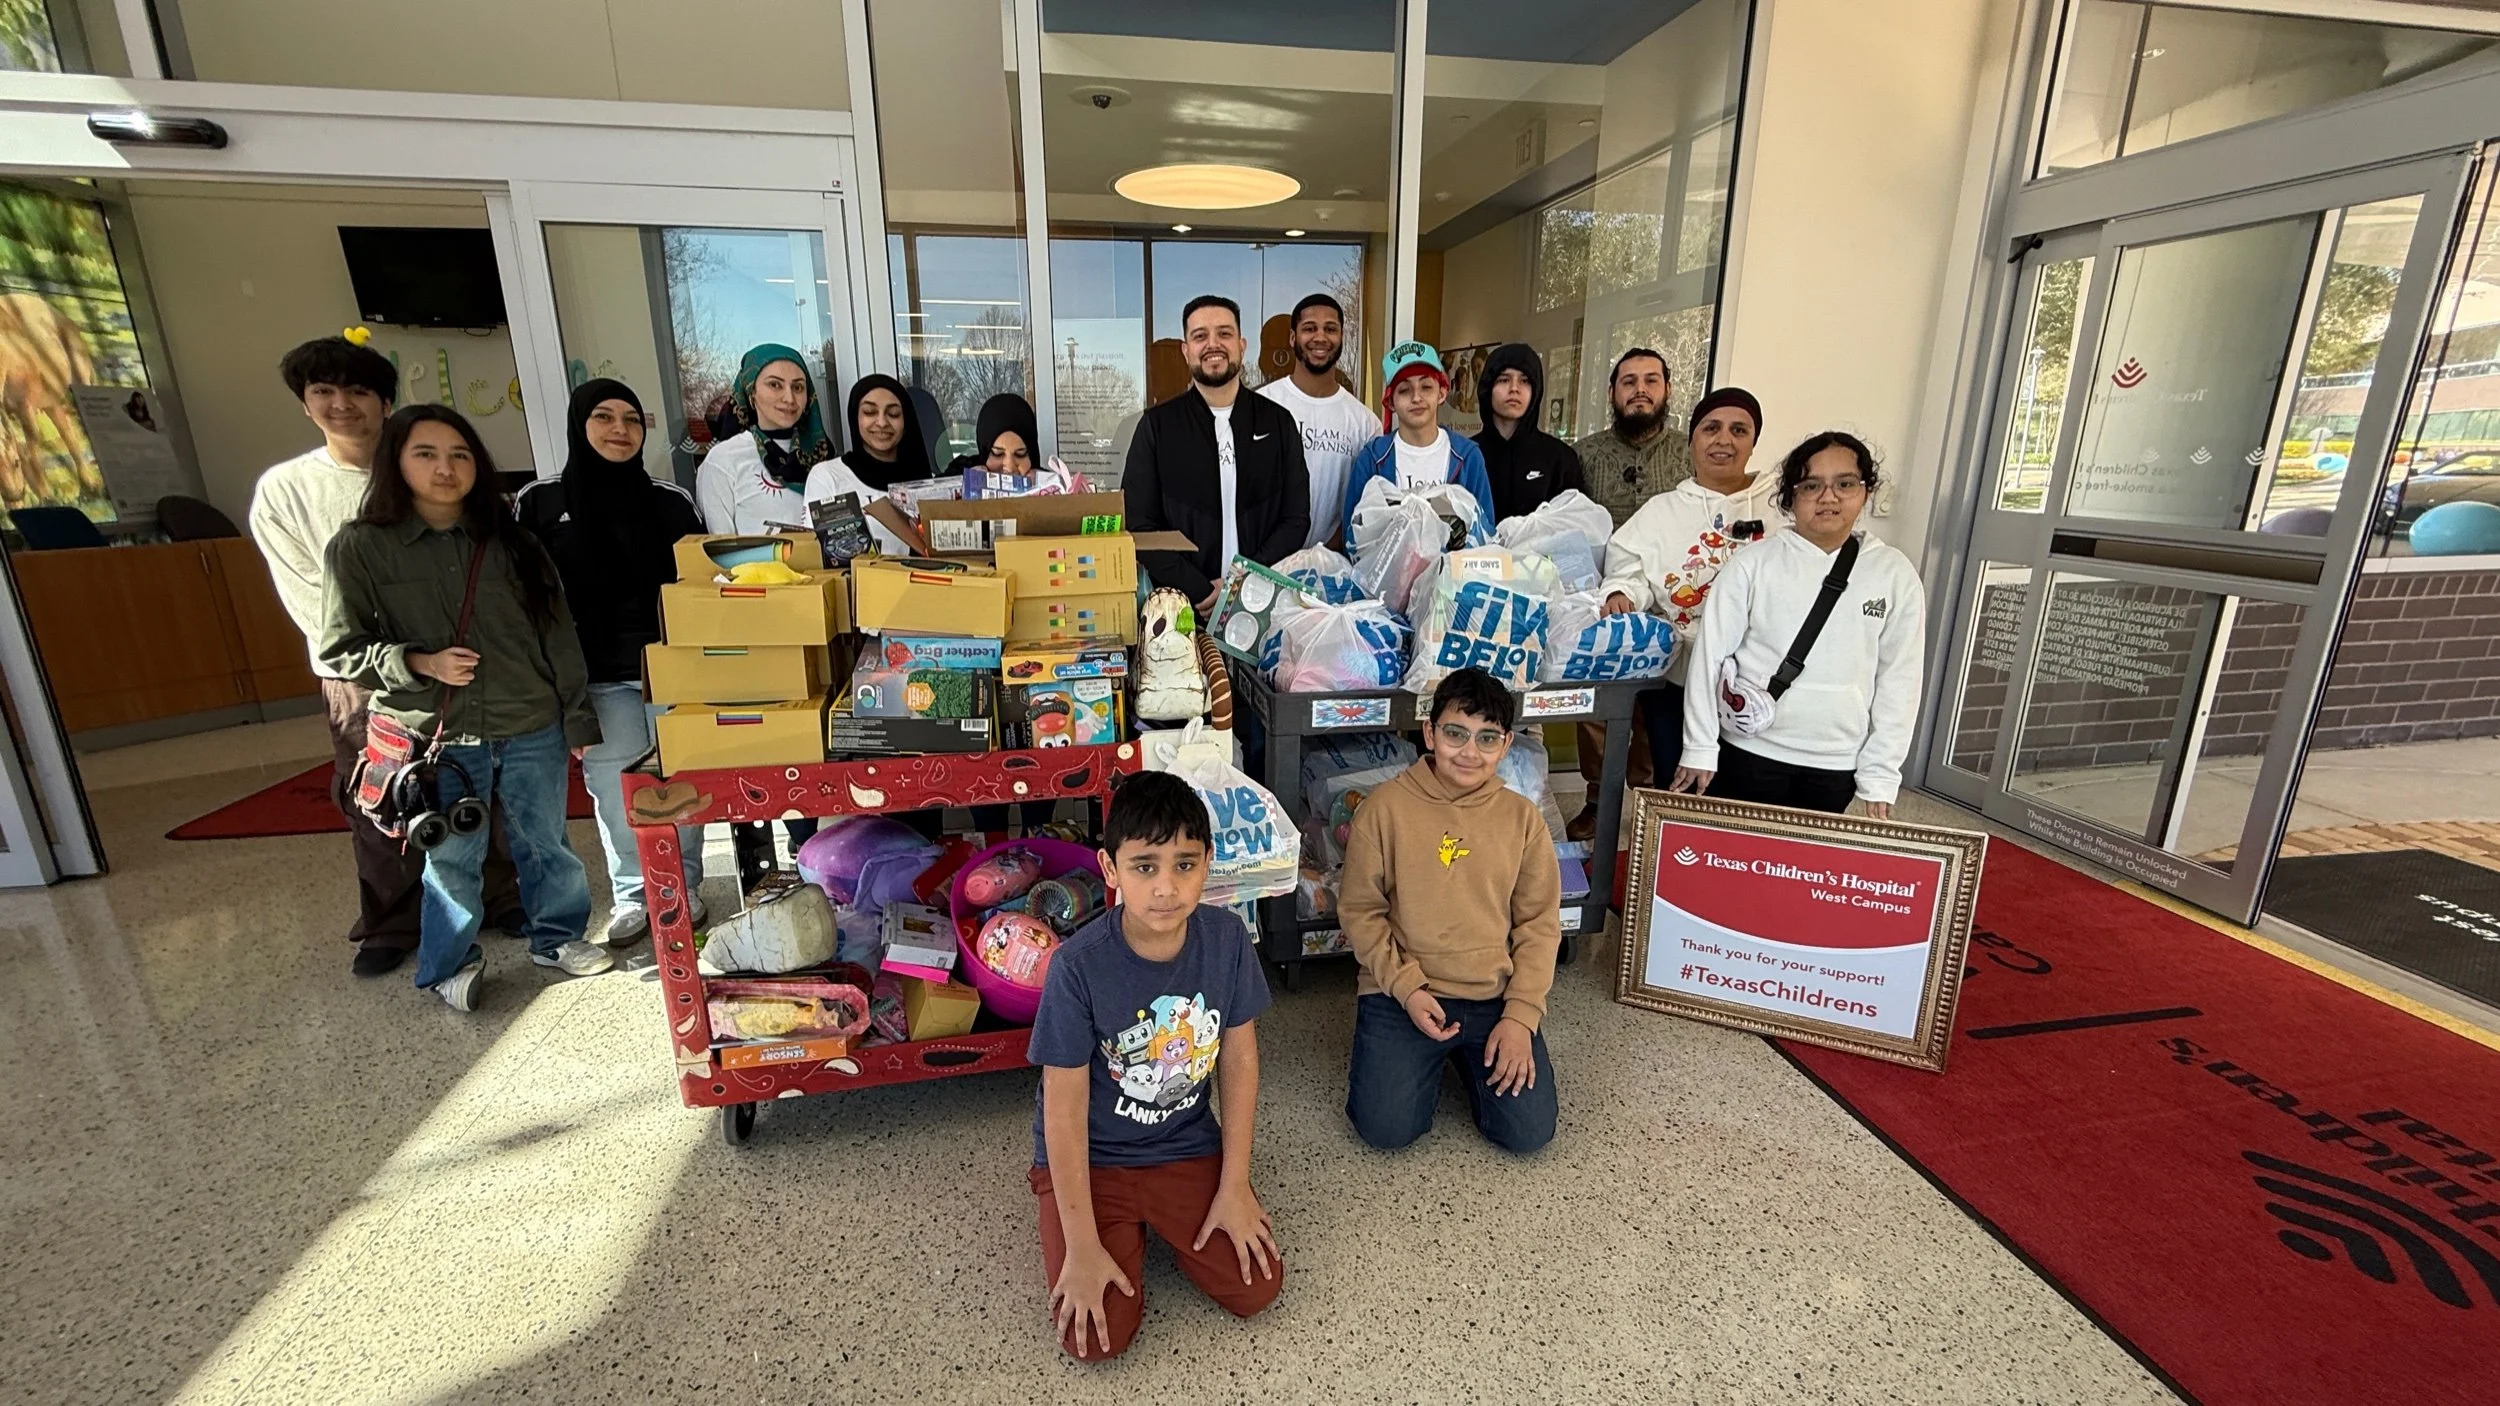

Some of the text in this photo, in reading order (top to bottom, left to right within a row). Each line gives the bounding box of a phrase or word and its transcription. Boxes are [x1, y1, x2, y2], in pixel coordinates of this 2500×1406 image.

[1862, 603, 1885, 619] VANS
[913, 644, 996, 659] Leather Bag
[2026, 807, 2188, 880] These Doors to Remain Unlocked
[2028, 820, 2178, 888] While the Building is Occupied
[1702, 851, 1916, 898] Texas Children's Hospital
[1810, 888, 1912, 915] West Campus
[1680, 937, 1886, 987] Thank you for your support!
[1679, 962, 1879, 1019] #TexasChildrens
[759, 1047, 805, 1062] SENSORY
[2157, 1034, 2500, 1243] hildren's
